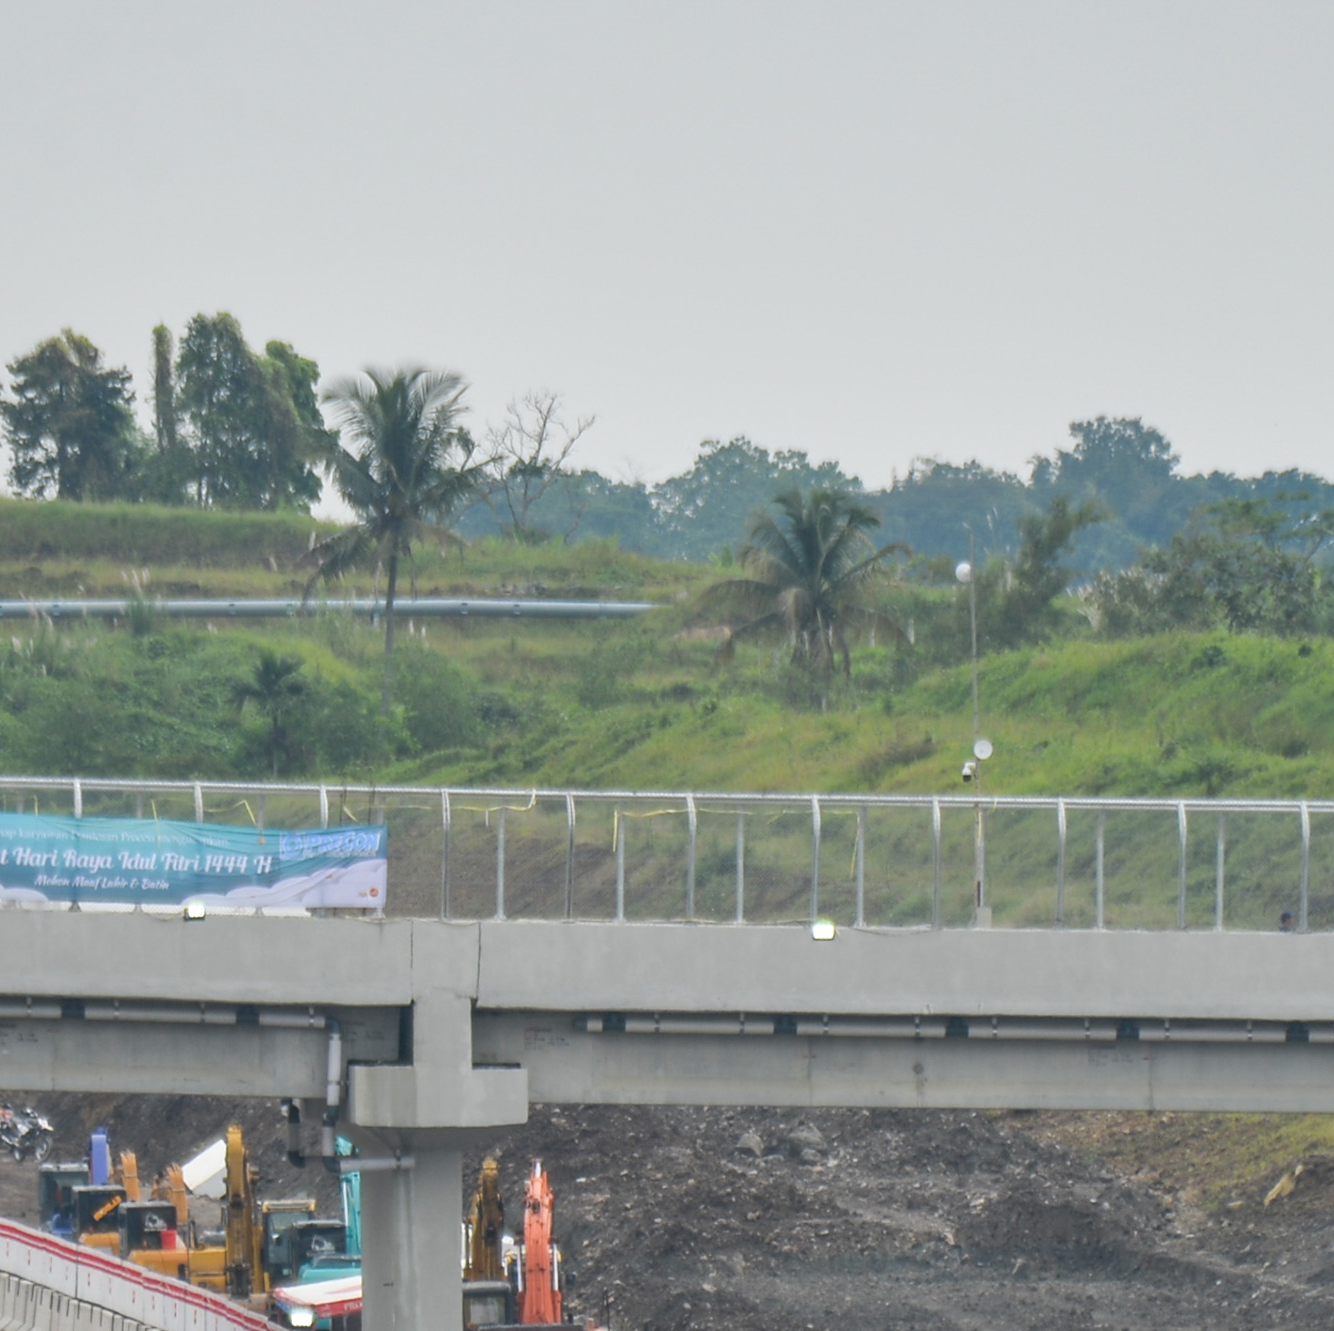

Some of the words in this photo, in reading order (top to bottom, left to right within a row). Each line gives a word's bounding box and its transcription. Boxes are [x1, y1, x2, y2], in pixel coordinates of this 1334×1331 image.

[12, 847, 58, 867] Hari
[63, 849, 114, 873] Raya
[118, 851, 157, 870] Idul
[161, 852, 201, 872] Fitri
[205, 855, 247, 874] 1444
[254, 856, 272, 874] H
[35, 874, 70, 887] Mohon
[72, 876, 102, 890] Maaf
